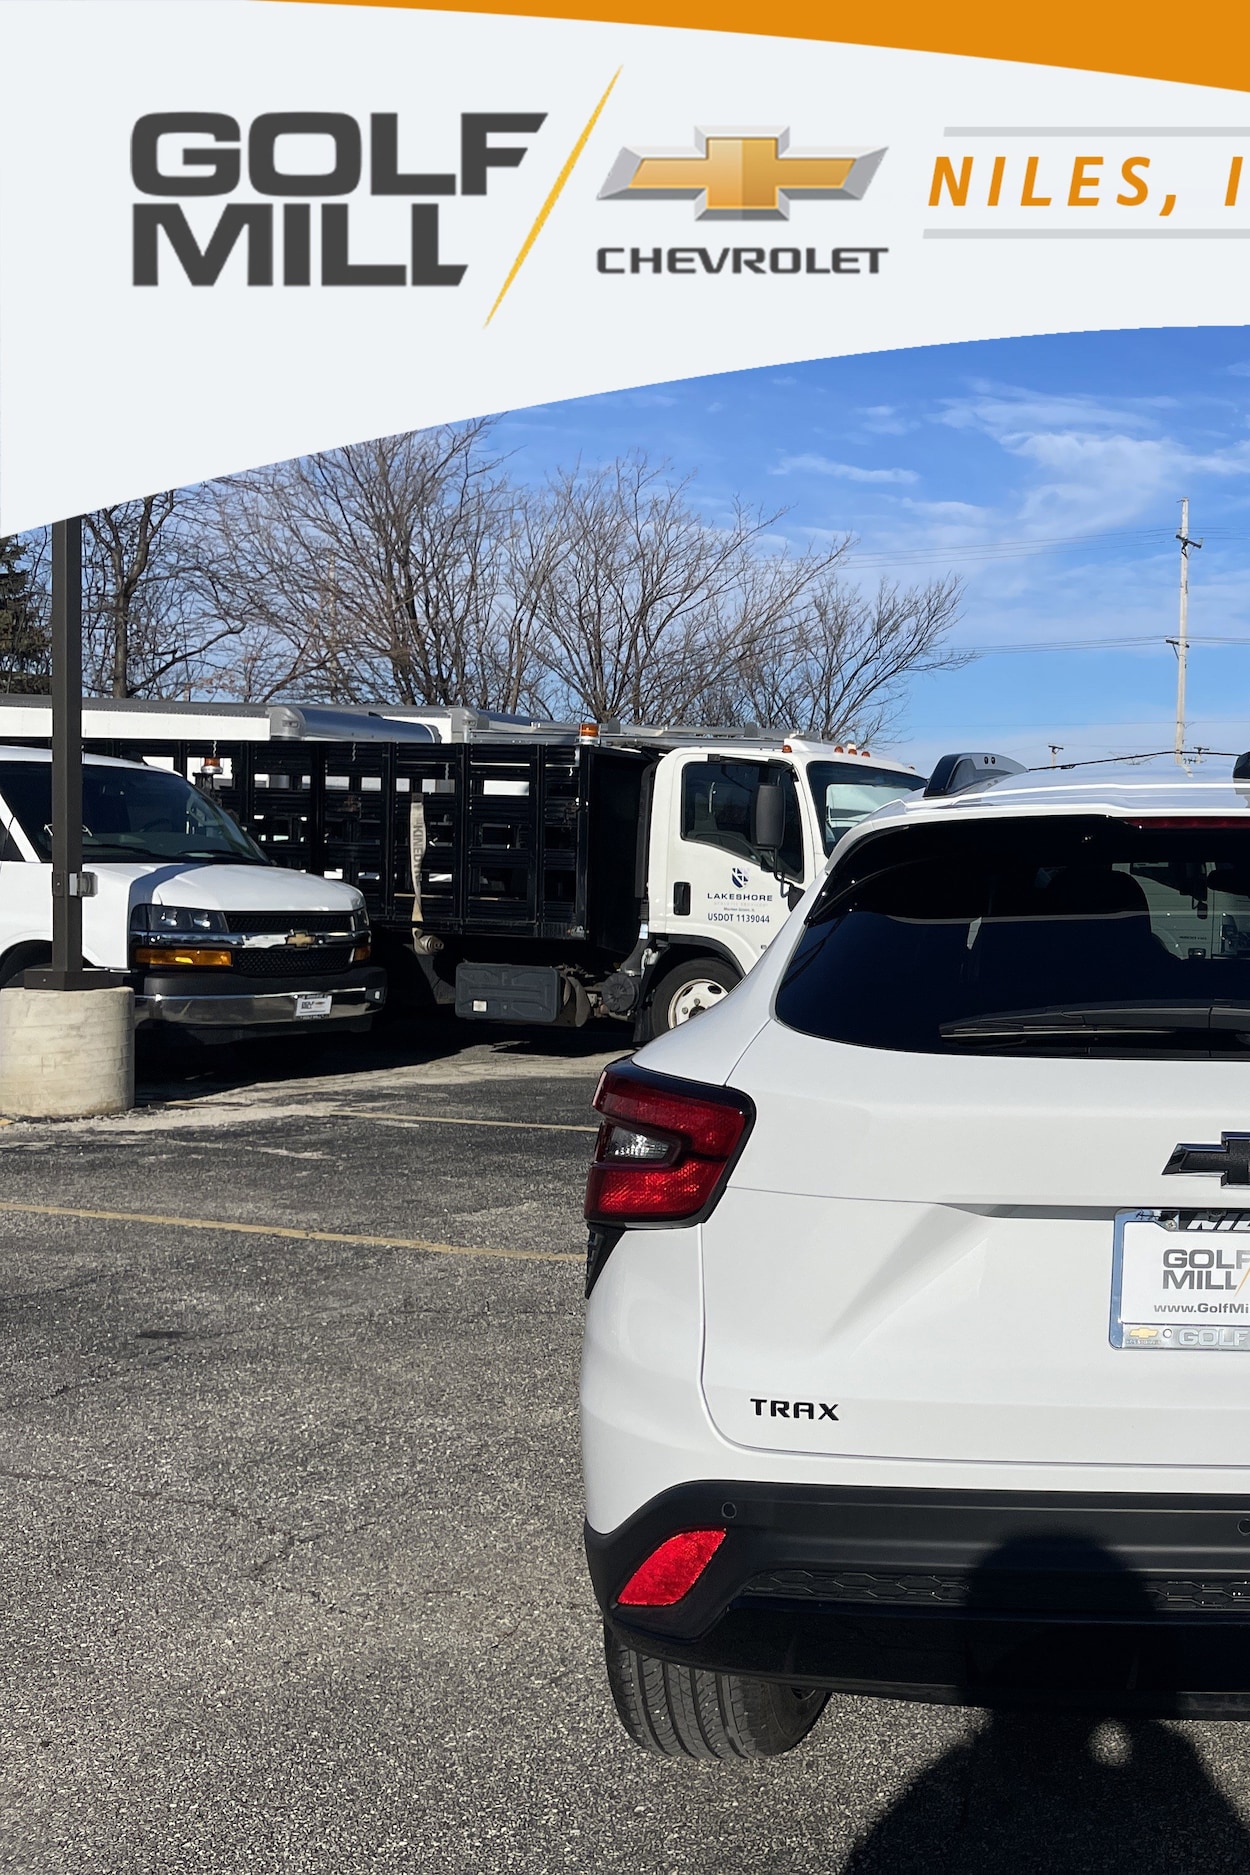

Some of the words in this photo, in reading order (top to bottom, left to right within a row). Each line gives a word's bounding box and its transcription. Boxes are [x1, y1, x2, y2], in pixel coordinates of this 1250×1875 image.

[707, 892, 773, 902] LAKESHORE
[707, 912, 734, 922] USDOT
[736, 913, 770, 924] 1139044
[1162, 1270, 1239, 1290] MILL
[1178, 1328, 1250, 1348] GOLF
[749, 1398, 840, 1421] TRAX
